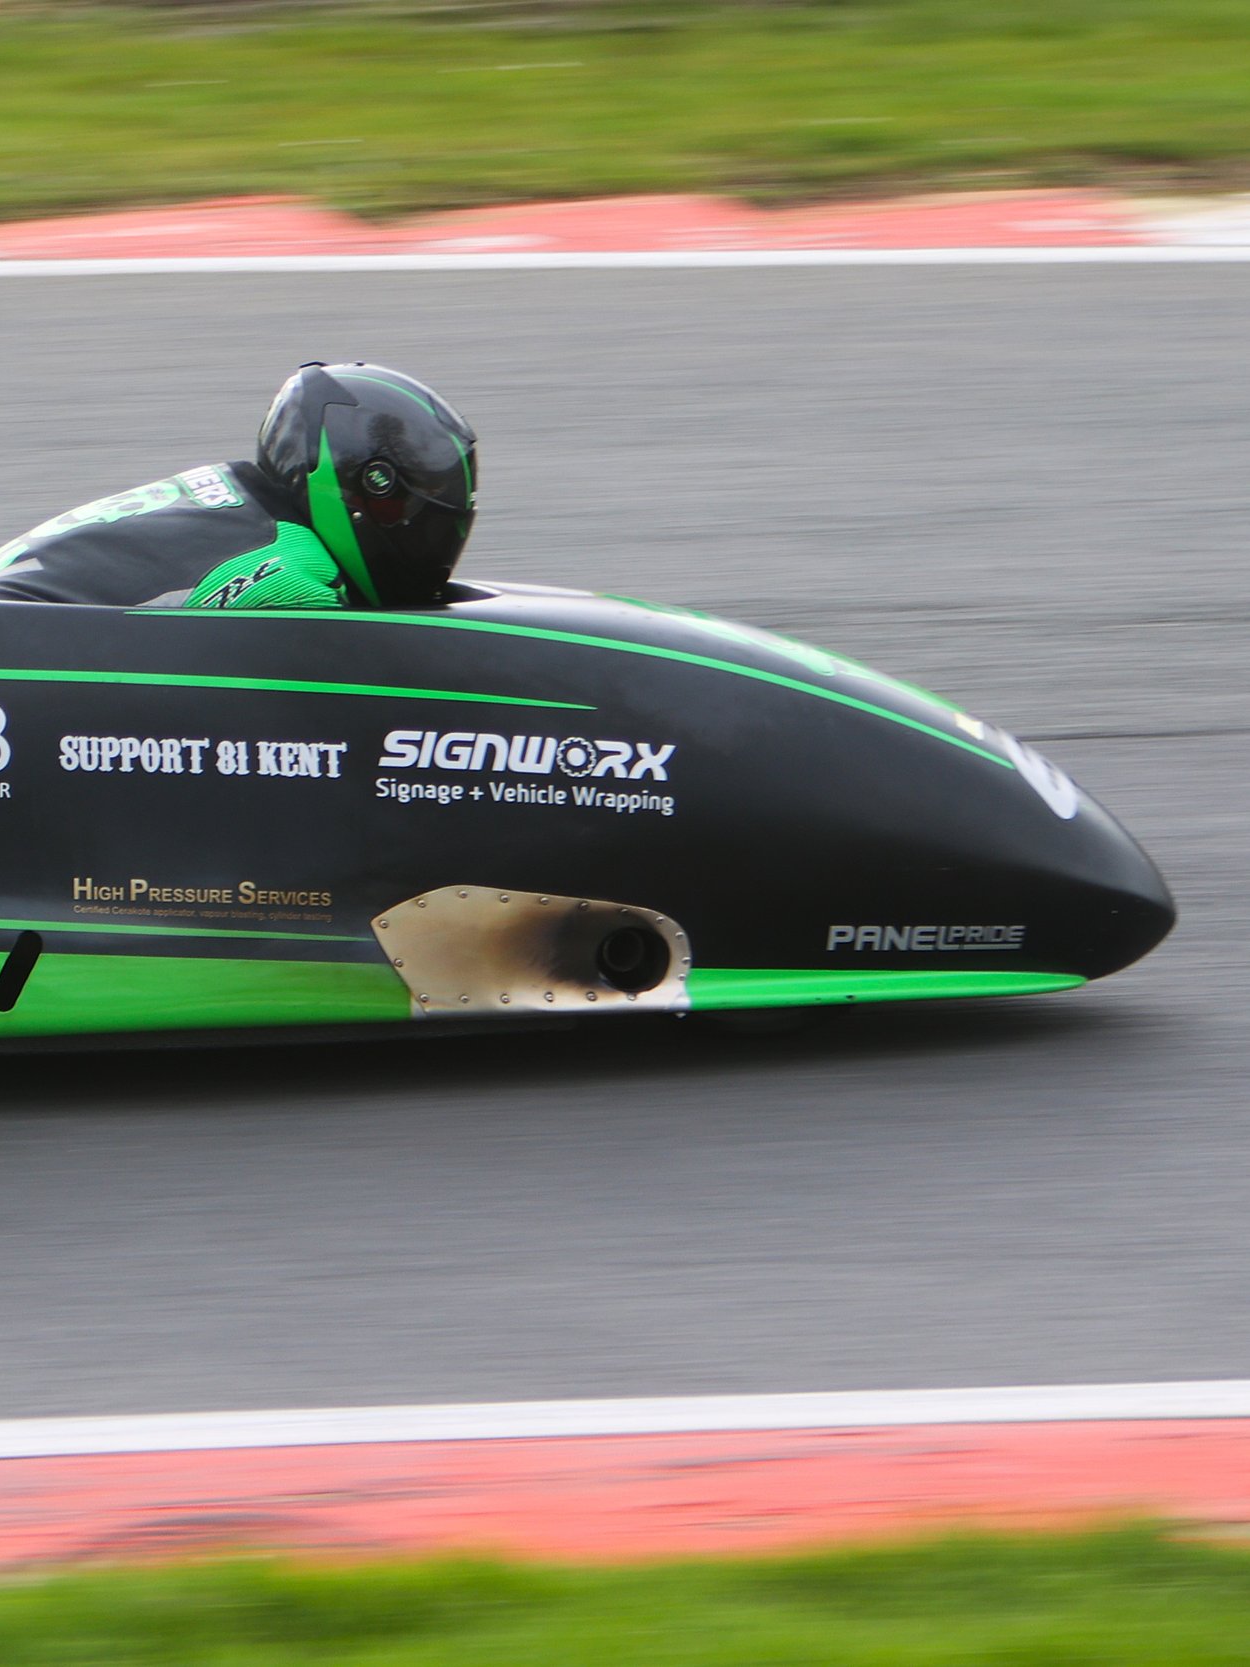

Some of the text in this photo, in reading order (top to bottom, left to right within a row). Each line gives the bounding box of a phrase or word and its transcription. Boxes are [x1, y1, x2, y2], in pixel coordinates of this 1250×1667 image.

[58, 735, 348, 778] SUPPORT 81 KENT
[377, 730, 677, 782] SIGNWORX
[375, 777, 465, 805] Signage
[489, 782, 568, 806] Vehicle
[572, 785, 675, 816] Wrapping
